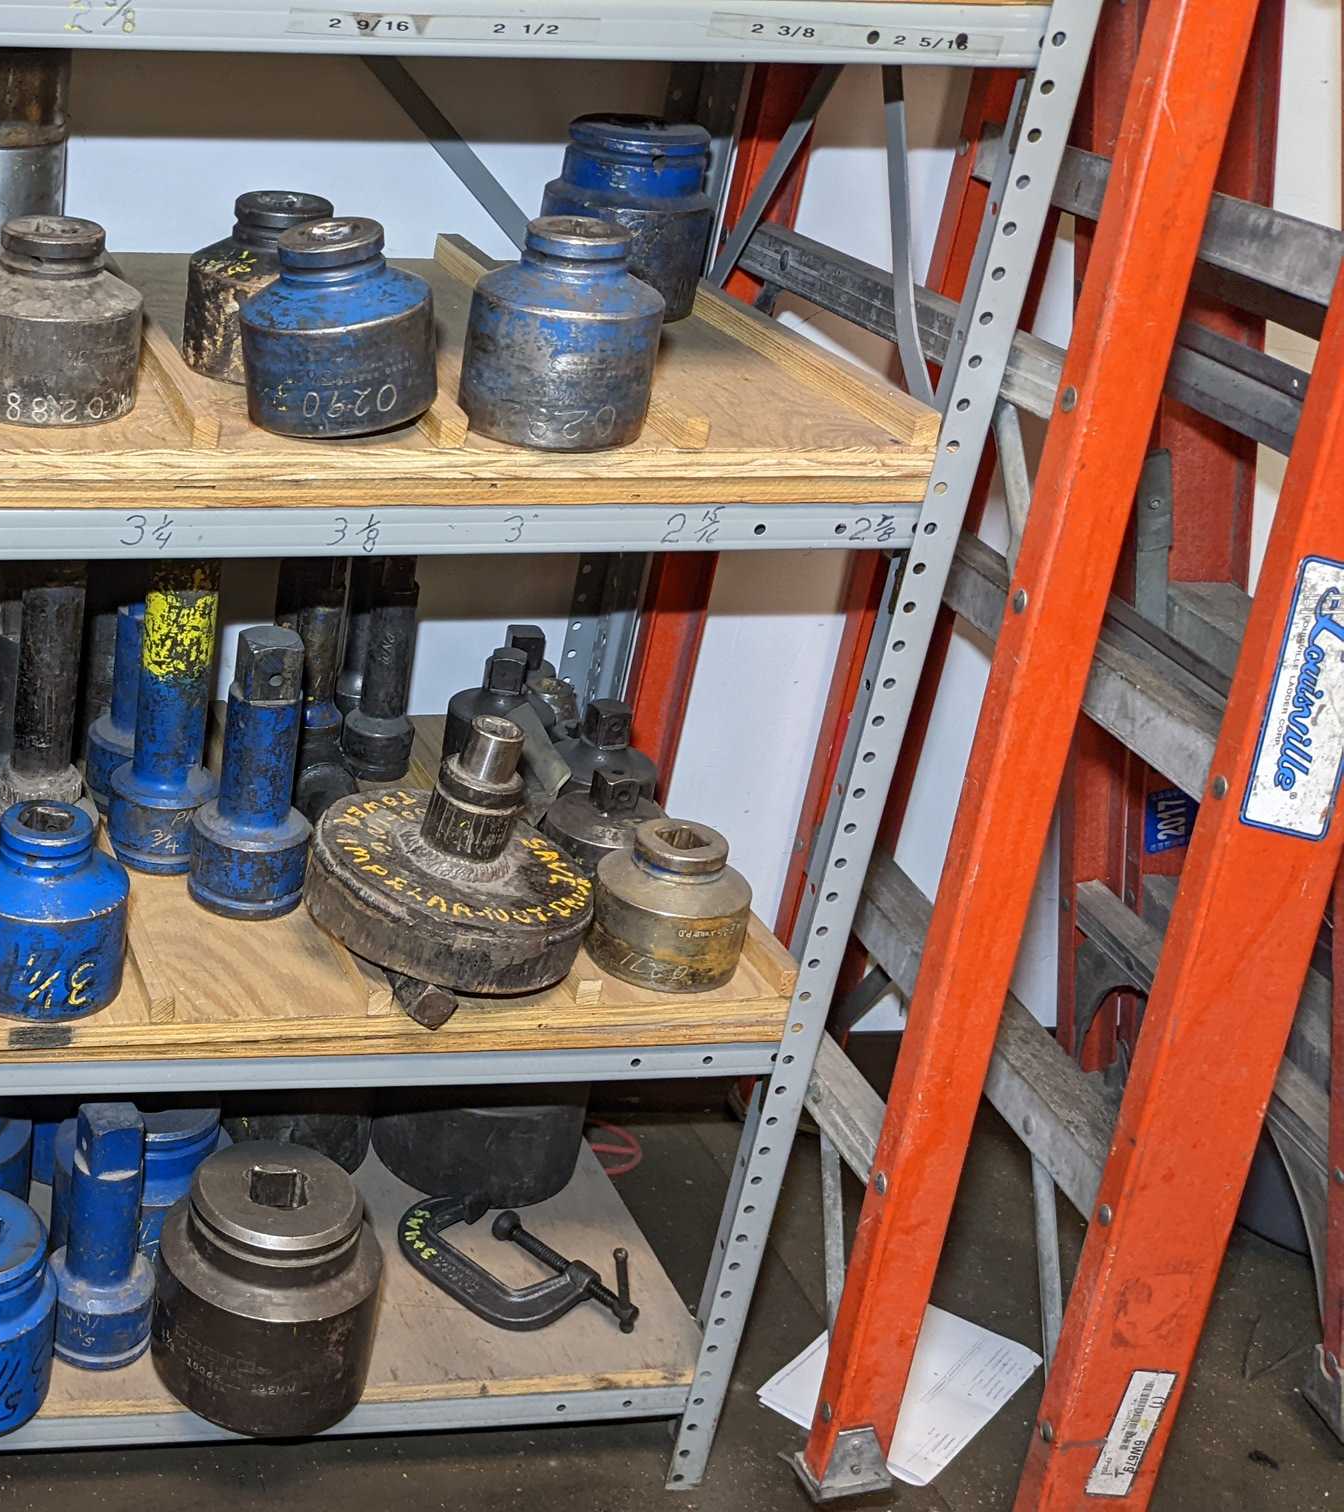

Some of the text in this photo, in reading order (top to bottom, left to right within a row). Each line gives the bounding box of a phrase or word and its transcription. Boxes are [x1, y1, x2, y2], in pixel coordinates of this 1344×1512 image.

[328, 17, 410, 32] 2 9/16
[493, 23, 560, 36] 2 1/2
[751, 23, 816, 39] 2 3/8
[893, 34, 906, 46] 2
[120, 513, 175, 550] 3 1/4
[326, 513, 382, 553] 3 1/8
[661, 512, 686, 544] 2
[848, 516, 872, 543] 2
[1273, 586, 1344, 792] Louisville
[1156, 799, 1188, 840] 2017
[66, 962, 95, 1007] 3
